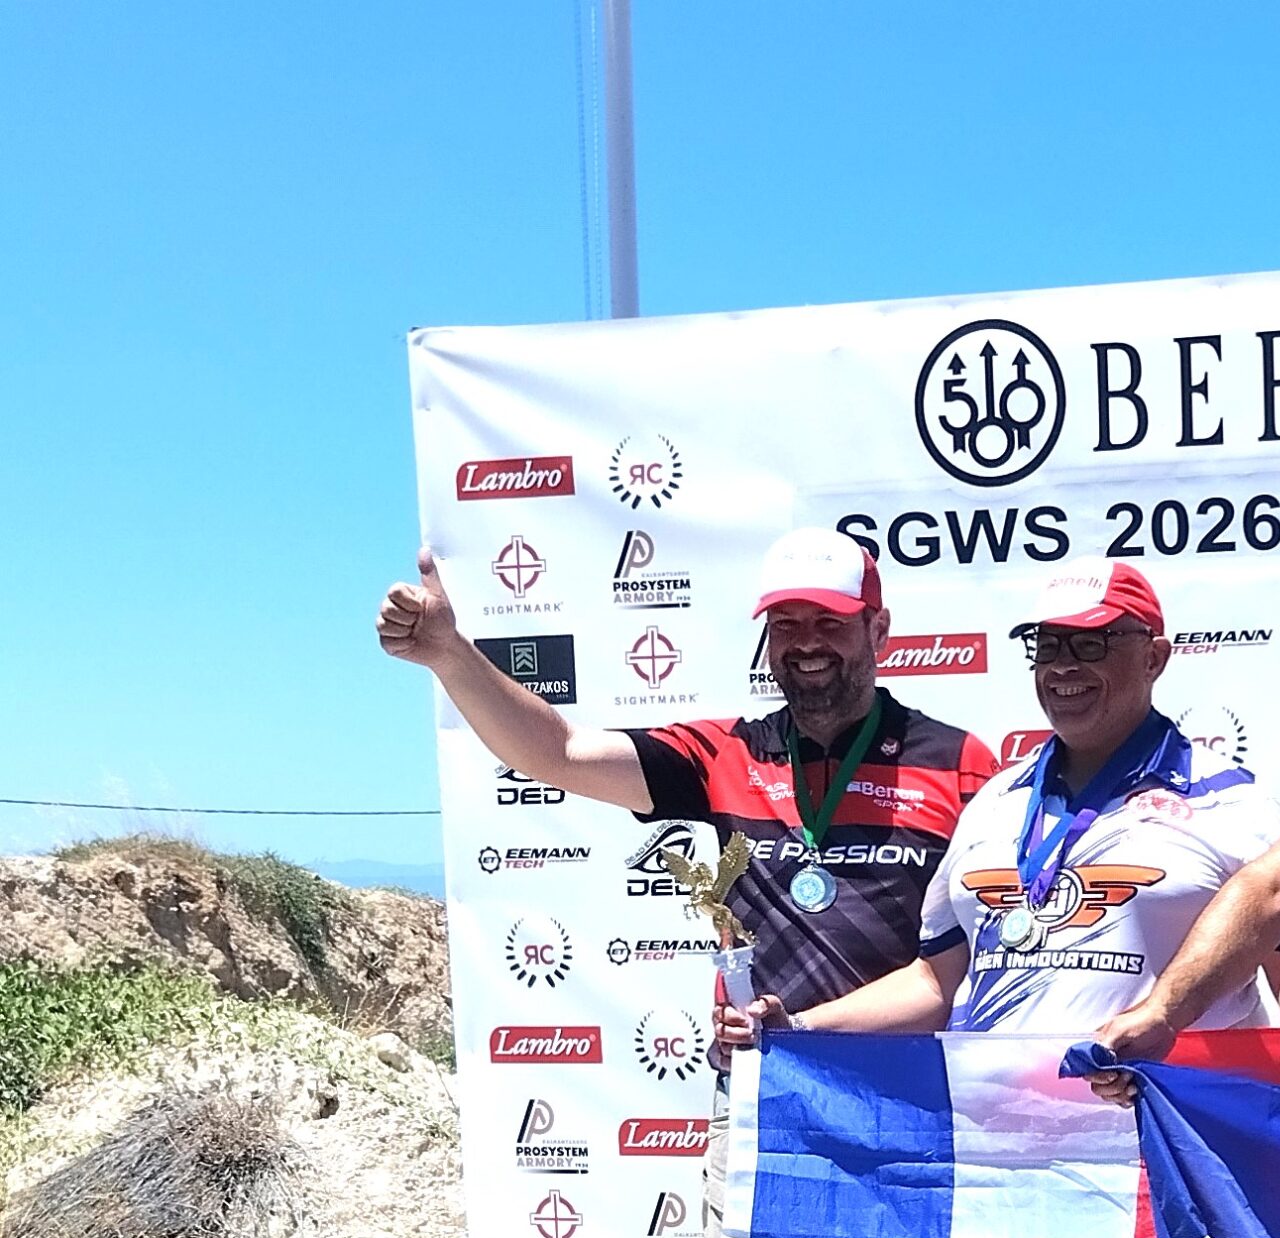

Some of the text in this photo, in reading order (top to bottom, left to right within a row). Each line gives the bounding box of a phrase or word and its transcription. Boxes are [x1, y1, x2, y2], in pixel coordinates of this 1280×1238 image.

[461, 460, 562, 492] Lambro
[836, 506, 1070, 567] SGWS
[612, 578, 692, 592] PROSYSTEM
[613, 591, 675, 604] ARMORY
[483, 602, 562, 616] SIGHTMARK
[1173, 629, 1274, 644] EEMANN
[1171, 644, 1219, 655] TECH
[613, 694, 698, 706] SIGHTMARK
[497, 786, 566, 806] DED
[505, 847, 592, 859] EEMANN
[778, 841, 928, 868] PASSION
[504, 860, 545, 869] TECH
[635, 940, 722, 951] EEMANN
[634, 951, 675, 961] TECH
[1006, 951, 1144, 974] INNOVATIONS
[494, 1028, 591, 1056] Lambro
[624, 1121, 709, 1149] Lambr
[515, 1146, 590, 1157] PROSYSTEM
[516, 1157, 573, 1168] ARMORY
